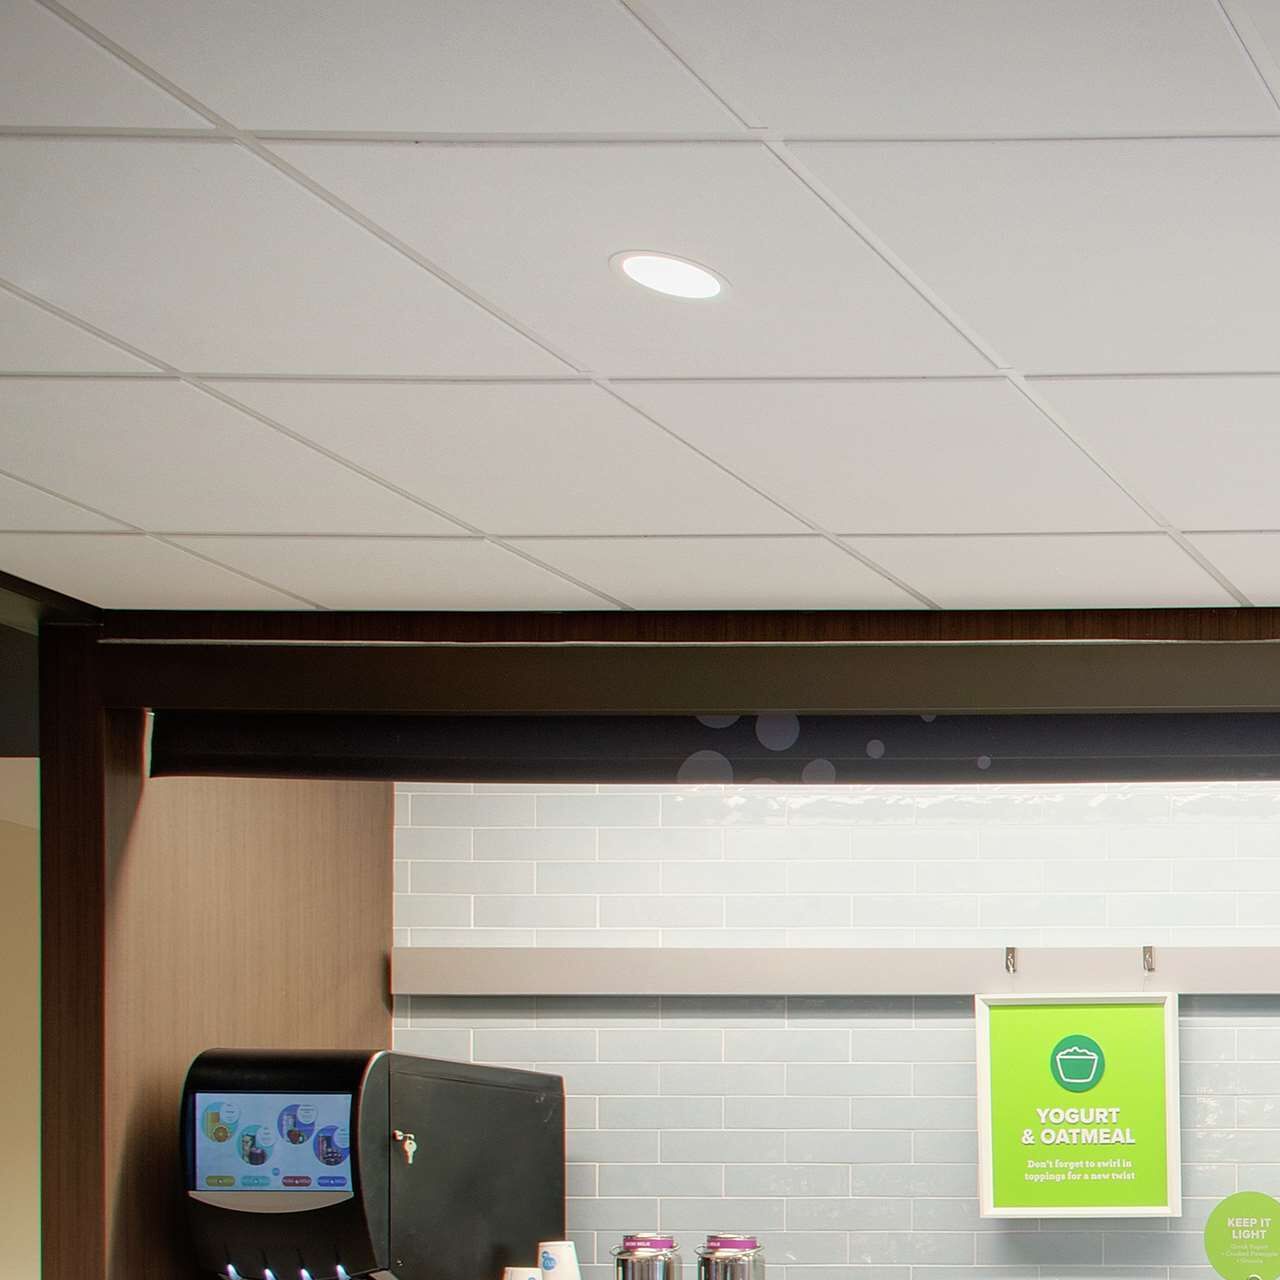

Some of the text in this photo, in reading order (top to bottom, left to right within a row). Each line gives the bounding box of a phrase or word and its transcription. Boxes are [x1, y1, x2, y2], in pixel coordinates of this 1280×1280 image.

[1036, 1108, 1120, 1124] YOGURT
[1021, 1128, 1136, 1144] & OATMEAL
[1027, 1160, 1053, 1168] Don't
[1055, 1160, 1083, 1170] forget
[1097, 1159, 1120, 1168] swirl
[1122, 1159, 1132, 1167] in
[1024, 1172, 1065, 1182] toppings
[1067, 1171, 1081, 1180] for
[1111, 1171, 1136, 1180] twist
[1227, 1217, 1272, 1228] KEEP IT
[1232, 1230, 1267, 1239] LIGHT
